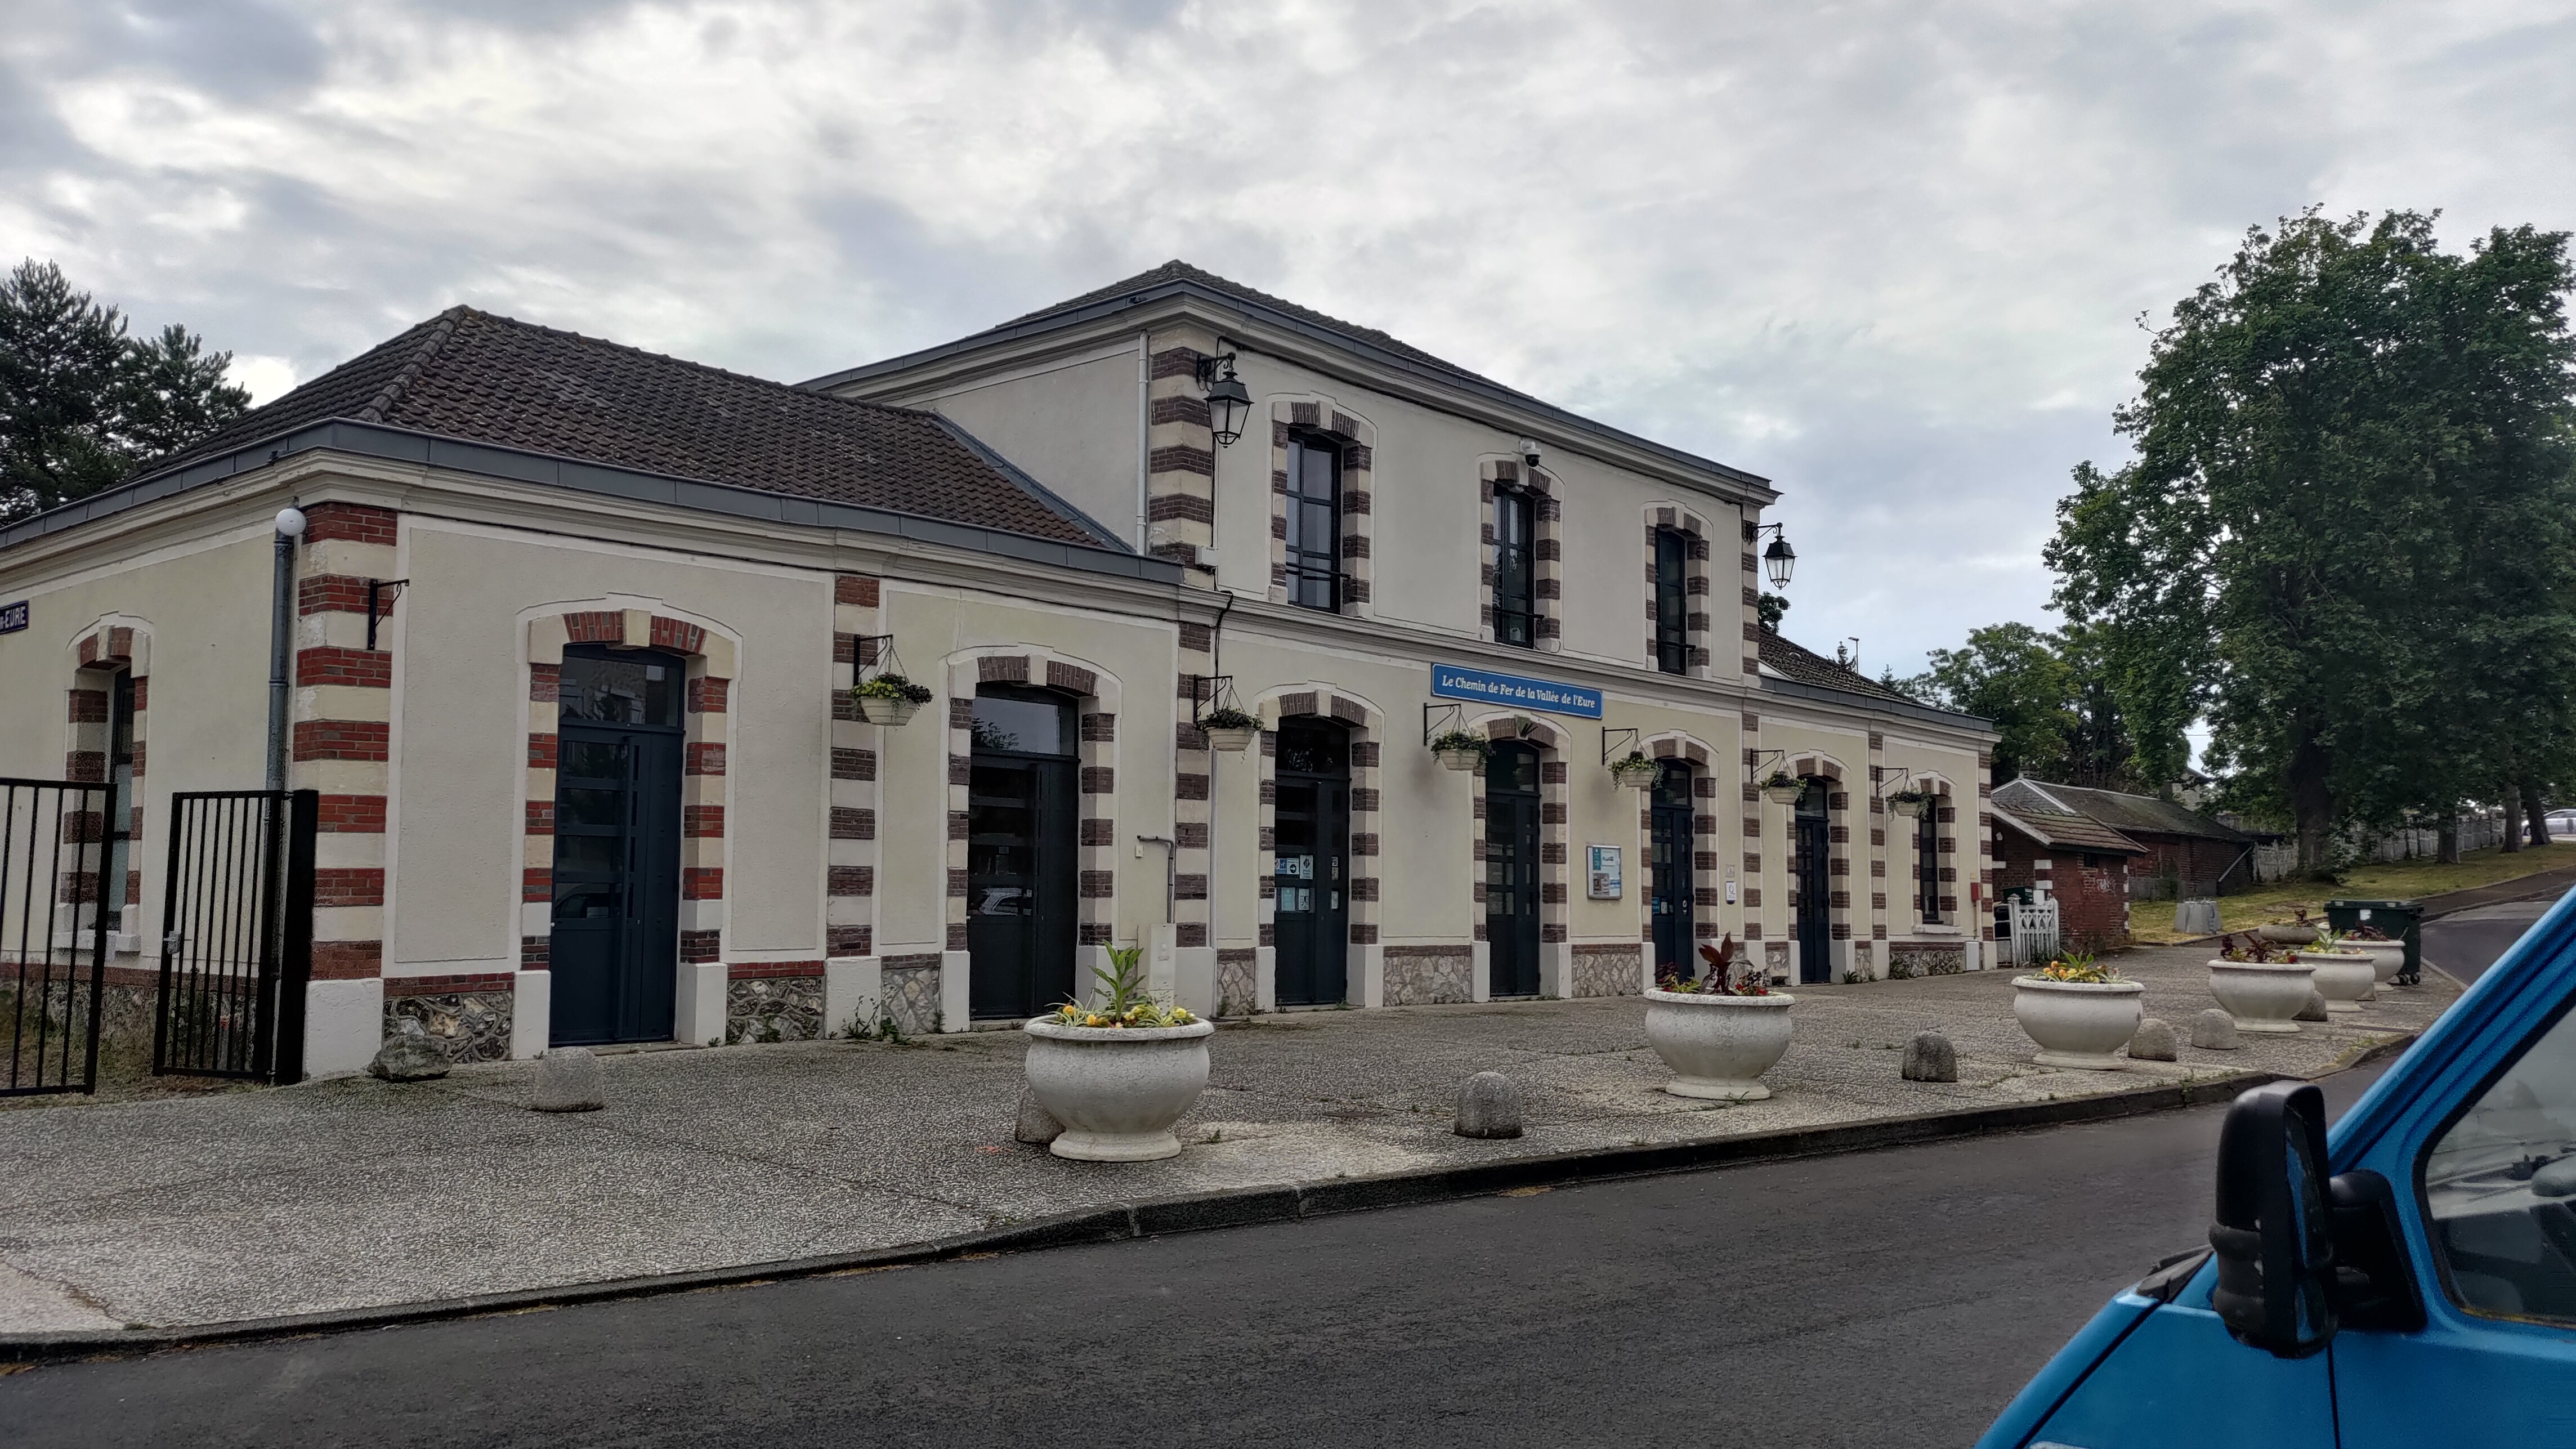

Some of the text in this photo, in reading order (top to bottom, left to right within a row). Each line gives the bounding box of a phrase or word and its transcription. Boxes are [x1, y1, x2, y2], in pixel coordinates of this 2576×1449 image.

[1442, 675, 1595, 708] Le Chemin de Fer de la Vallée de l'Eure
